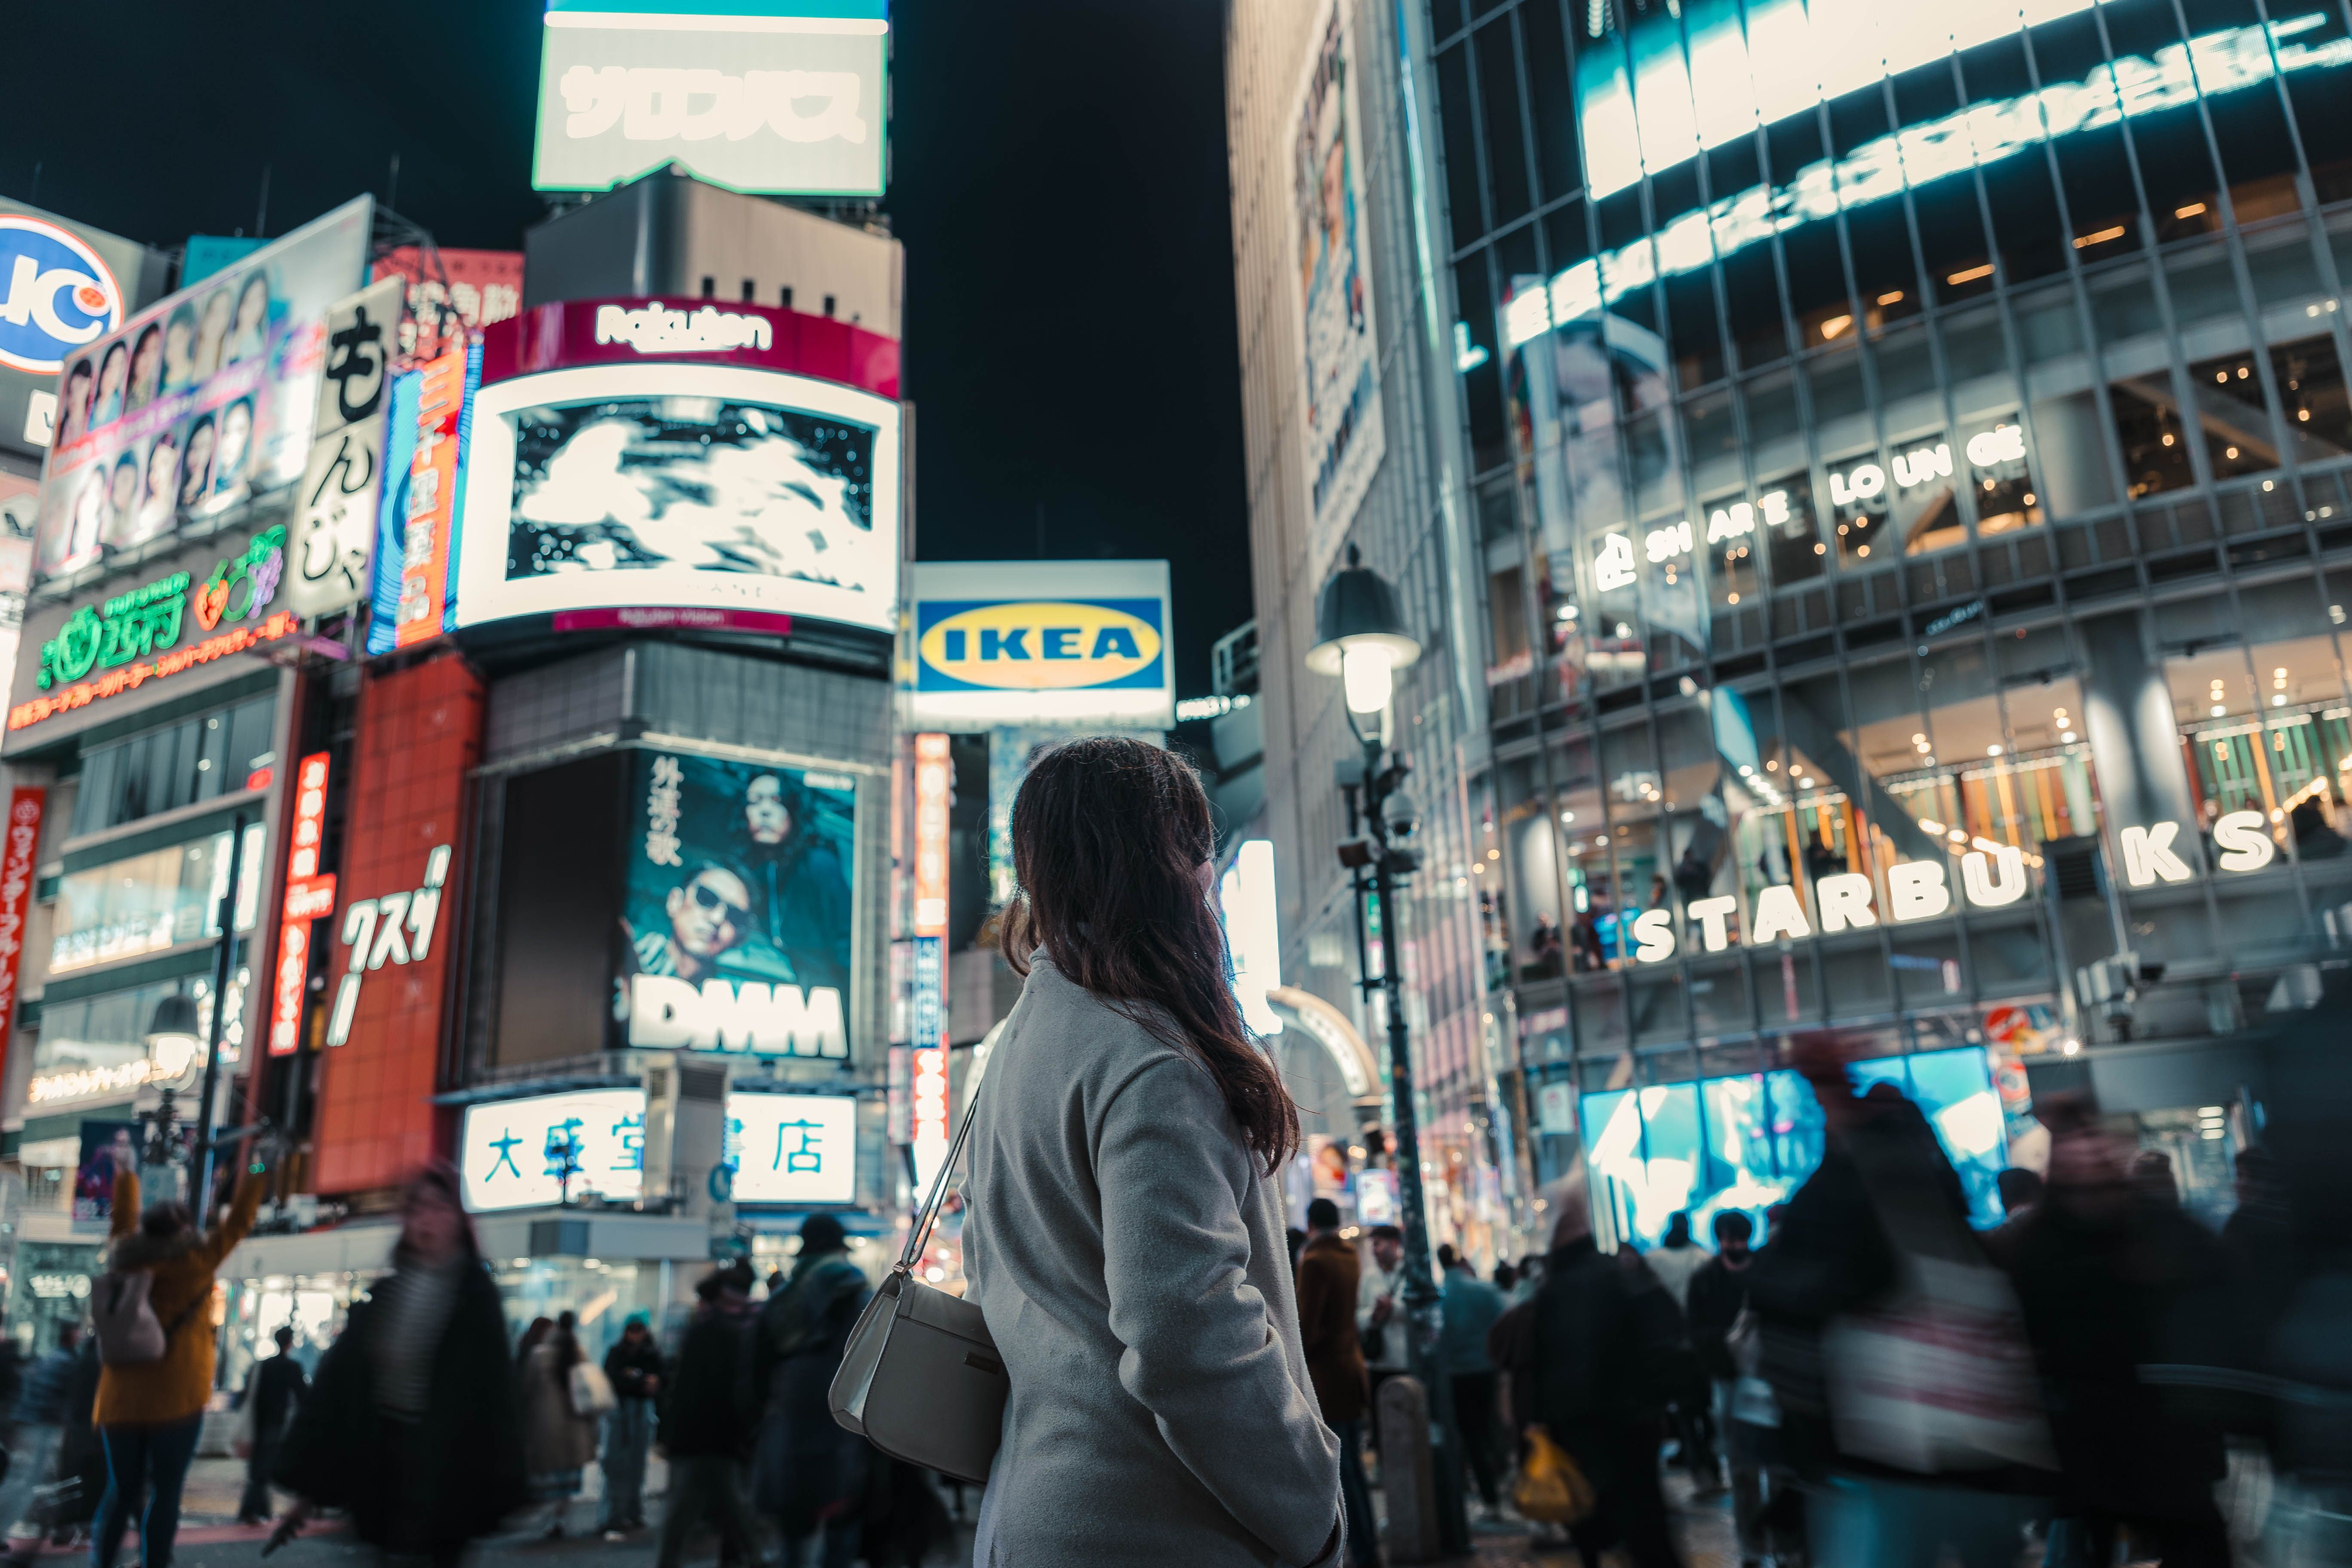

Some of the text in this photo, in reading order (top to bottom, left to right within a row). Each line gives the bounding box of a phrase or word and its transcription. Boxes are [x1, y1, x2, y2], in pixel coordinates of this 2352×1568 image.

[560, 65, 866, 144] サロンパス
[596, 302, 772, 353] Rakuten
[1645, 425, 2027, 563] SHARE LOUNGE
[945, 628, 1141, 662] IKEA
[1633, 810, 2274, 964] STARBUKS
[327, 844, 451, 1046] クスリ
[629, 973, 848, 1059] DMM
